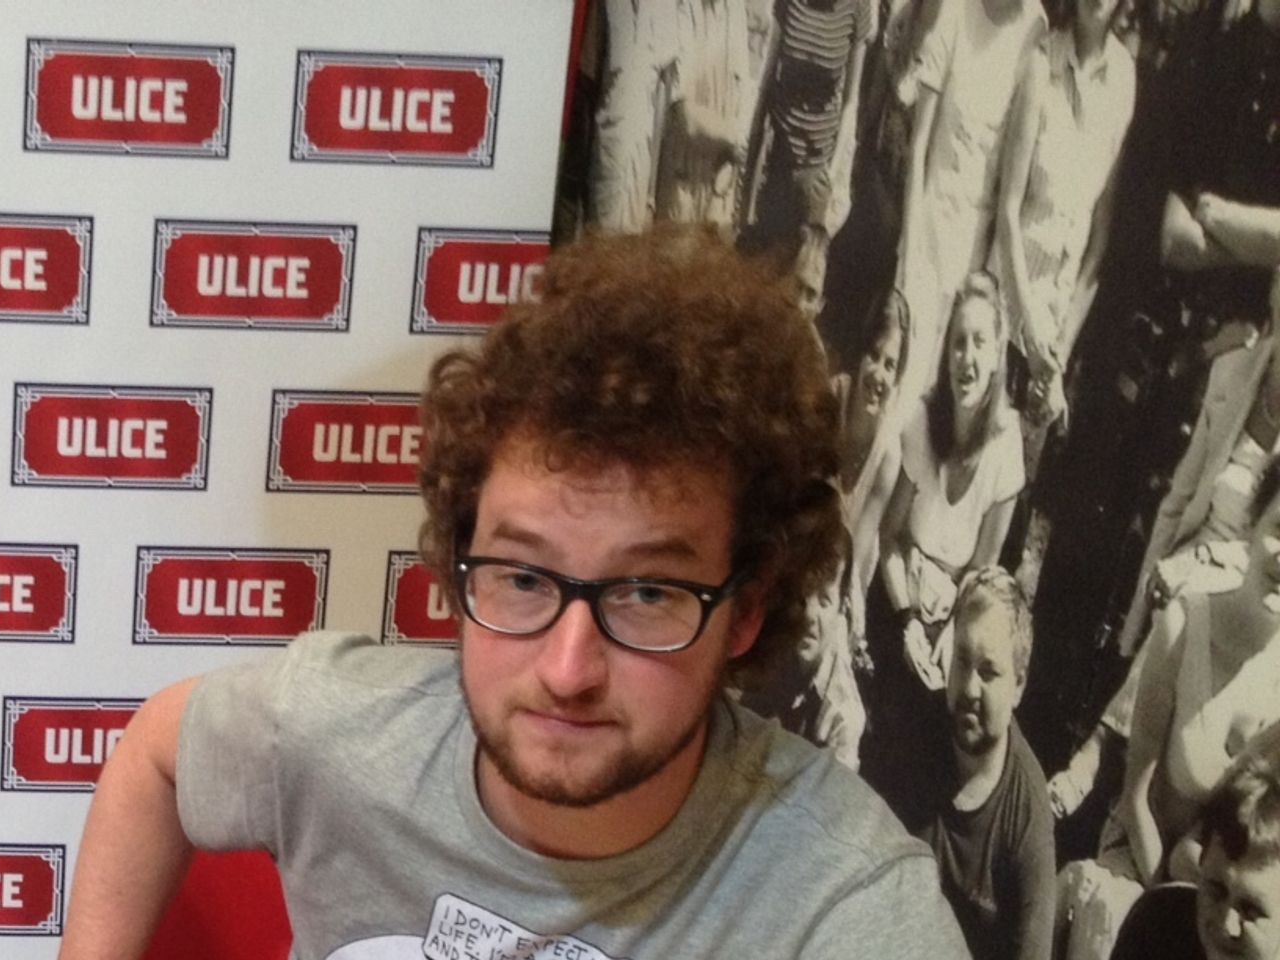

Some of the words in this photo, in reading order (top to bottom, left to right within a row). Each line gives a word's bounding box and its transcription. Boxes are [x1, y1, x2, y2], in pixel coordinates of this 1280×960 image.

[72, 76, 188, 123] ULICE
[340, 87, 455, 133] ULICE
[198, 256, 310, 298] ULICE
[458, 262, 544, 304] ULIC
[58, 418, 167, 458] ULICE
[313, 423, 423, 464] ULICE
[178, 579, 284, 616] ULICE
[454, 908, 513, 943] DON'T
